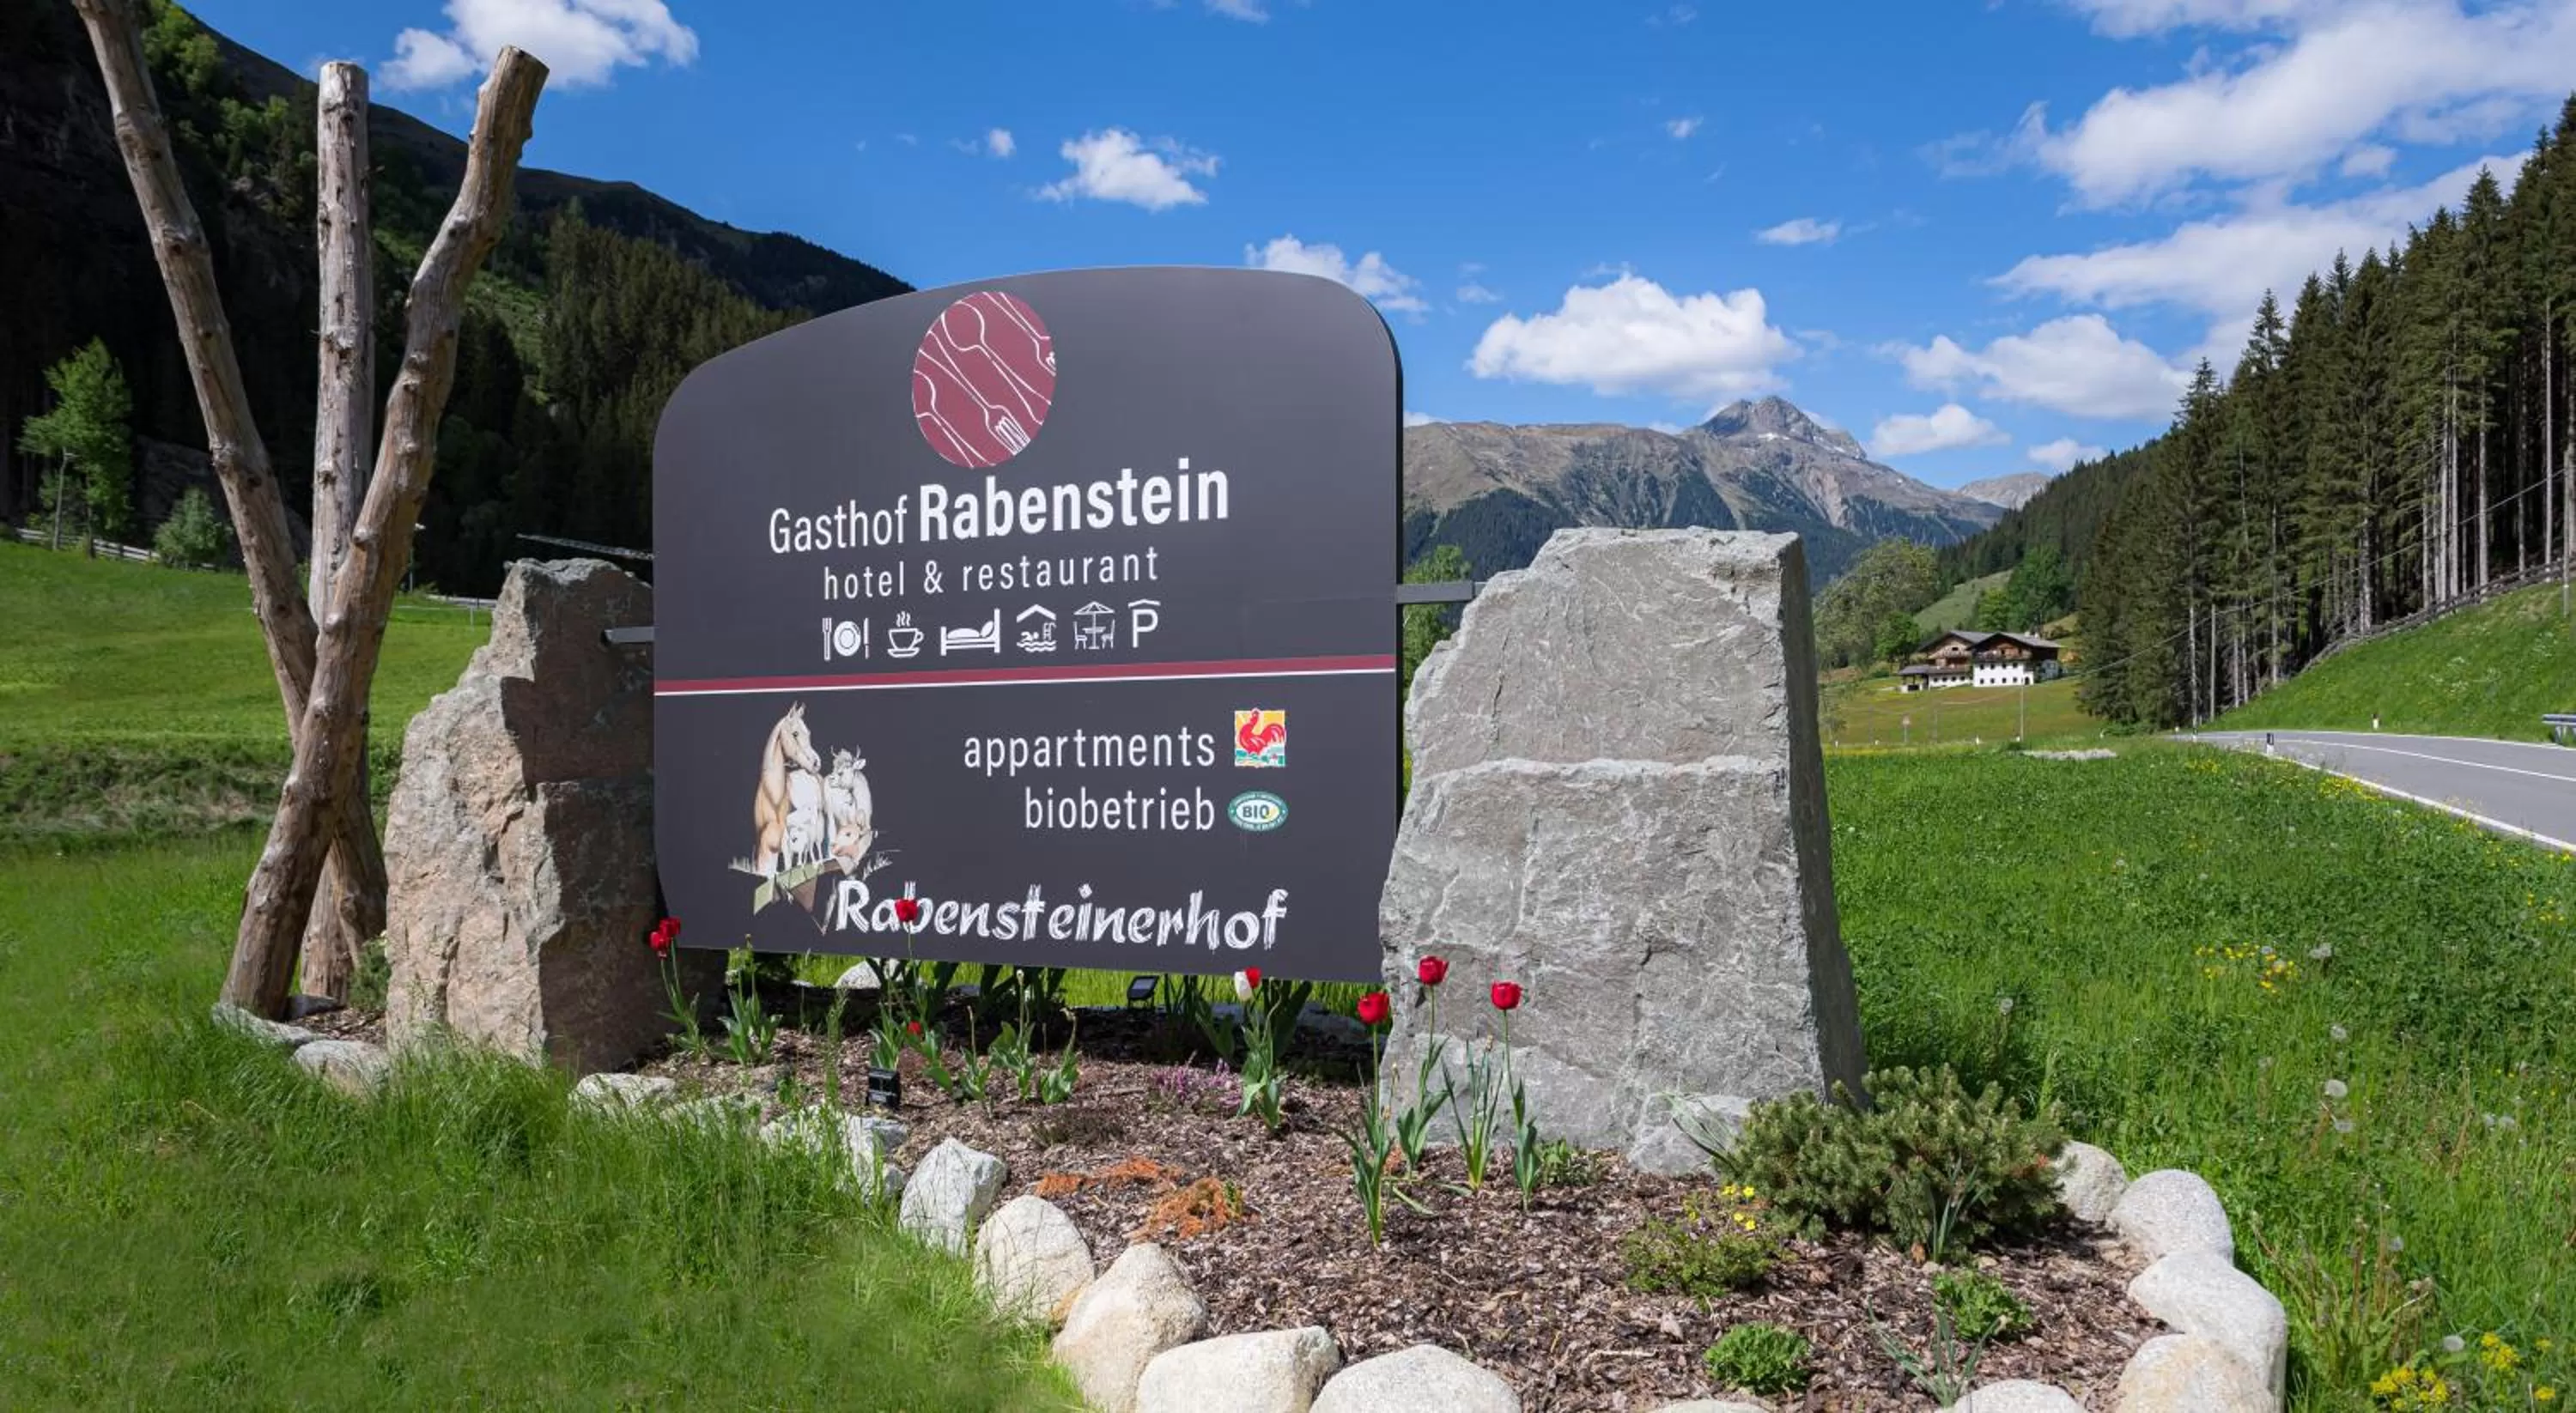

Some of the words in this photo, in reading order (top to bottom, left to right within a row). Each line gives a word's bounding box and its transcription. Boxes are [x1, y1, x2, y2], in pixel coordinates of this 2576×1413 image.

[769, 494, 908, 554] Gasthof
[920, 457, 1229, 543] Rabenstein
[823, 561, 904, 600] hotel
[923, 560, 945, 595] &
[963, 546, 1158, 591] restaurant
[964, 726, 1216, 777] appartments
[1025, 786, 1216, 831] biobetrieb
[1242, 804, 1270, 819] BIO
[836, 880, 1289, 951] Rabensteinerhof
